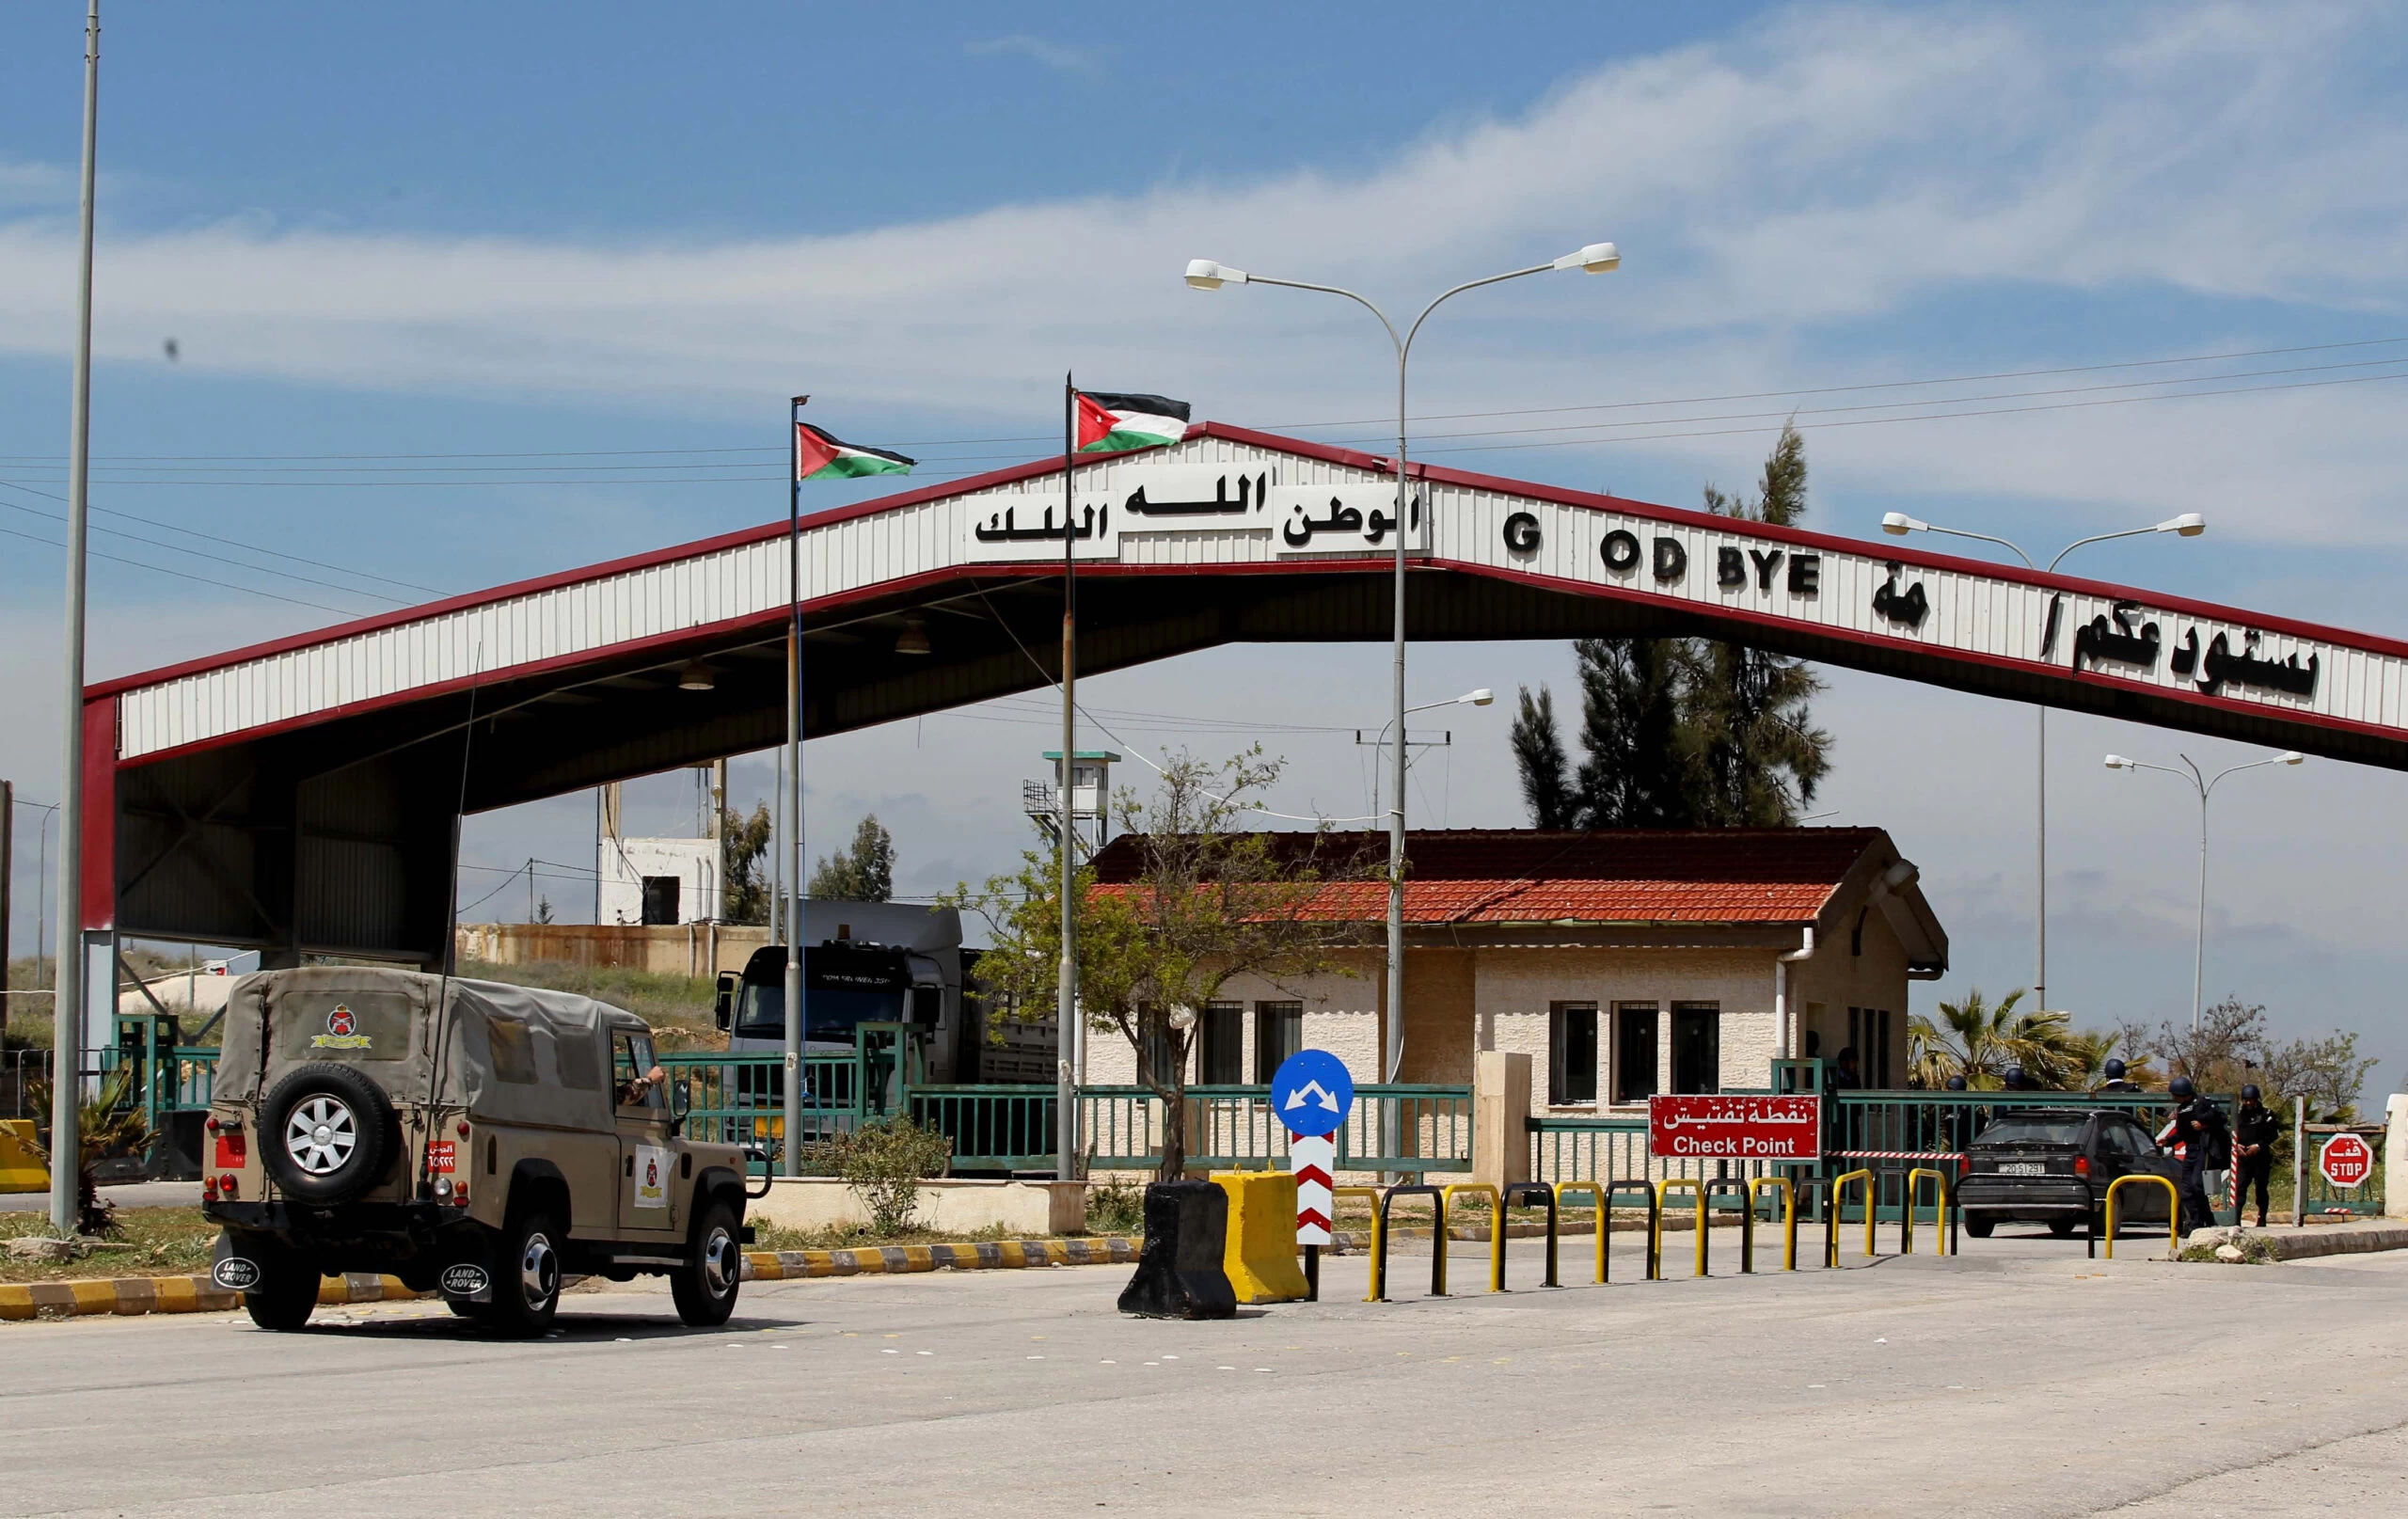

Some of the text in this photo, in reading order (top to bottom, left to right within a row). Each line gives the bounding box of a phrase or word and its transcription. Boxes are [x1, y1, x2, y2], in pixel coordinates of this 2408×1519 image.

[1125, 471, 1267, 515] الله
[974, 502, 1108, 542] الملك
[1283, 495, 1420, 547] الوطن
[1718, 546, 1820, 593] BYE
[1663, 1102, 1808, 1130] نقطة تفتيش
[1673, 1136, 1795, 1154] Check Point
[2329, 1141, 2362, 1157] قف
[2331, 1163, 2363, 1177] STOP
[223, 1262, 246, 1272] LAND
[450, 1270, 475, 1278] LAND
[224, 1272, 251, 1283] ROVER
[451, 1279, 482, 1289] ROVER
